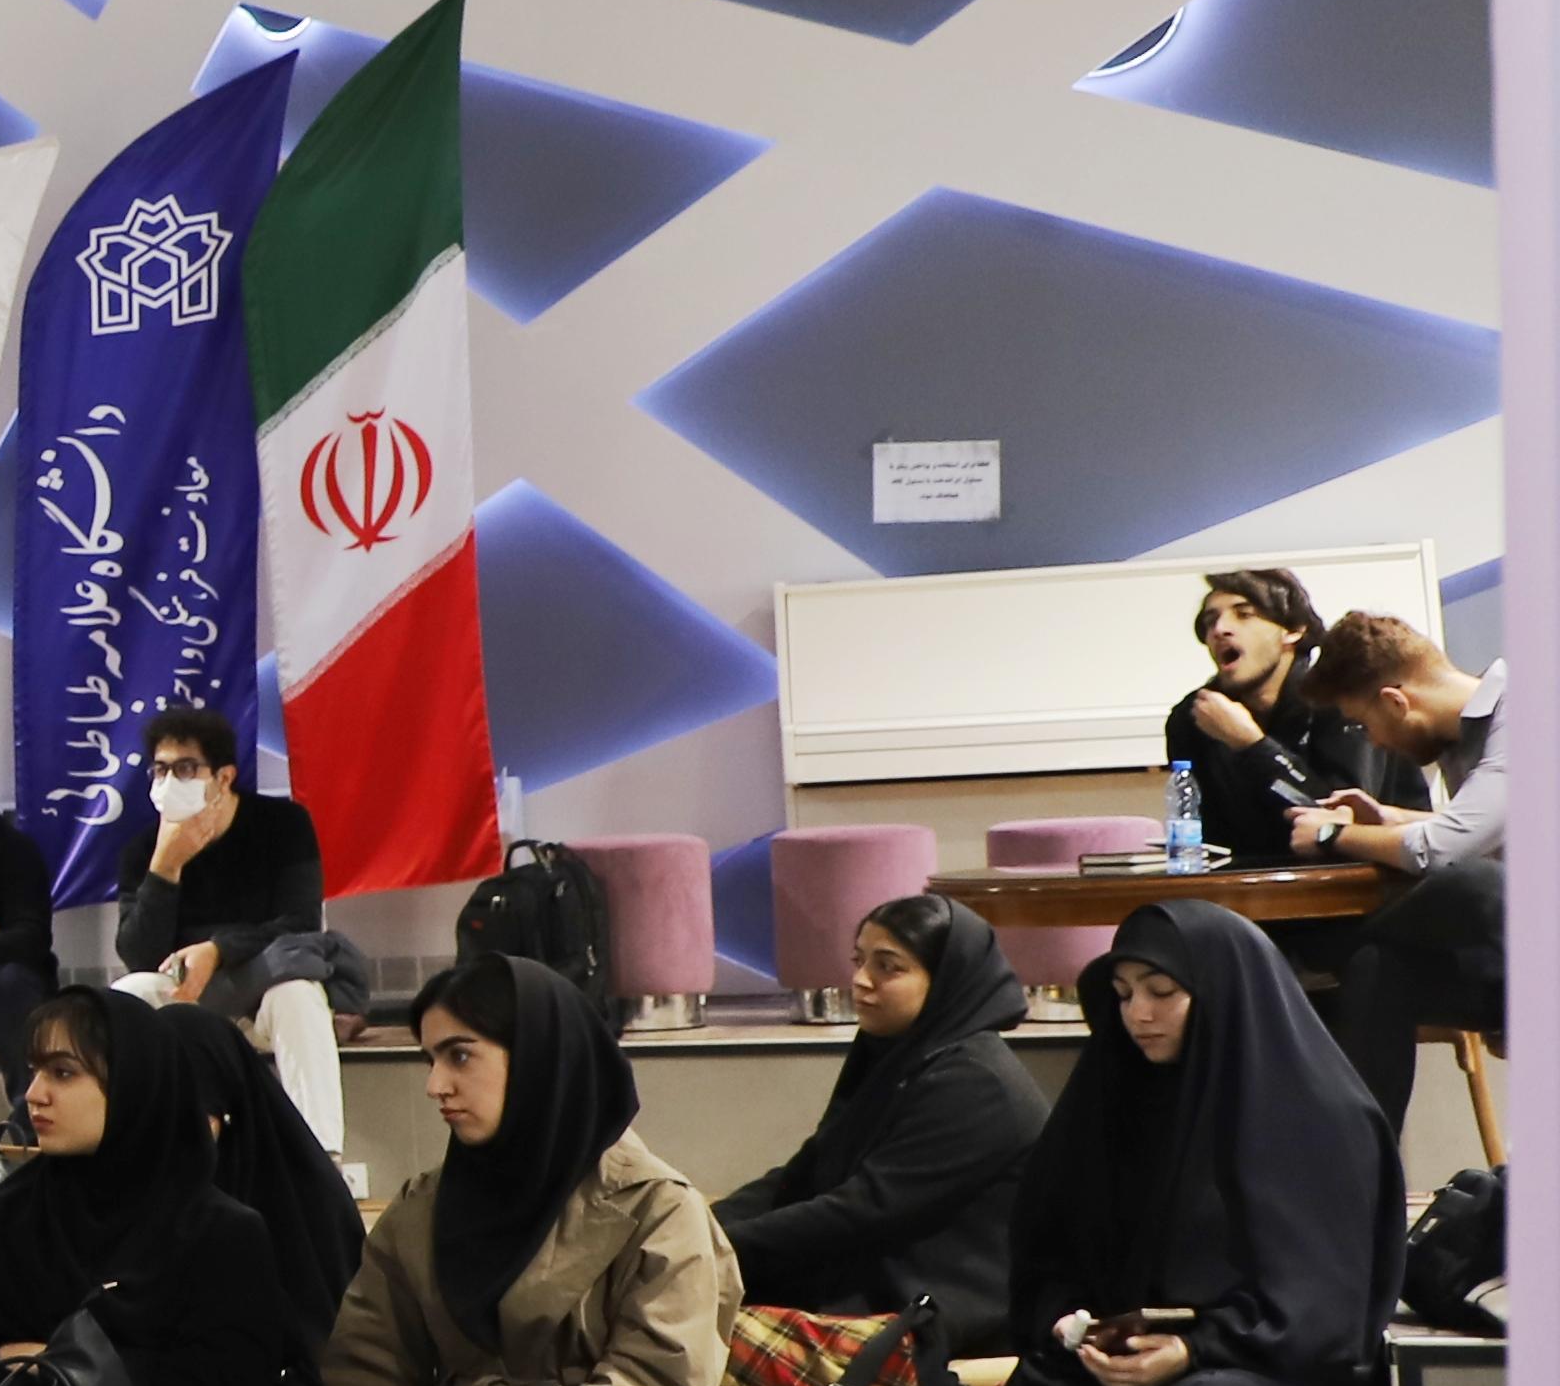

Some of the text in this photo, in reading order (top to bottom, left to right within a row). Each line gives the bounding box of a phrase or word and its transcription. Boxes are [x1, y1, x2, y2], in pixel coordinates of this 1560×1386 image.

[37, 404, 126, 579] دانشگاه
[160, 455, 212, 565] معاونت
[59, 580, 124, 681] علامه
[128, 567, 221, 646] فرهنگی
[180, 647, 206, 664] و
